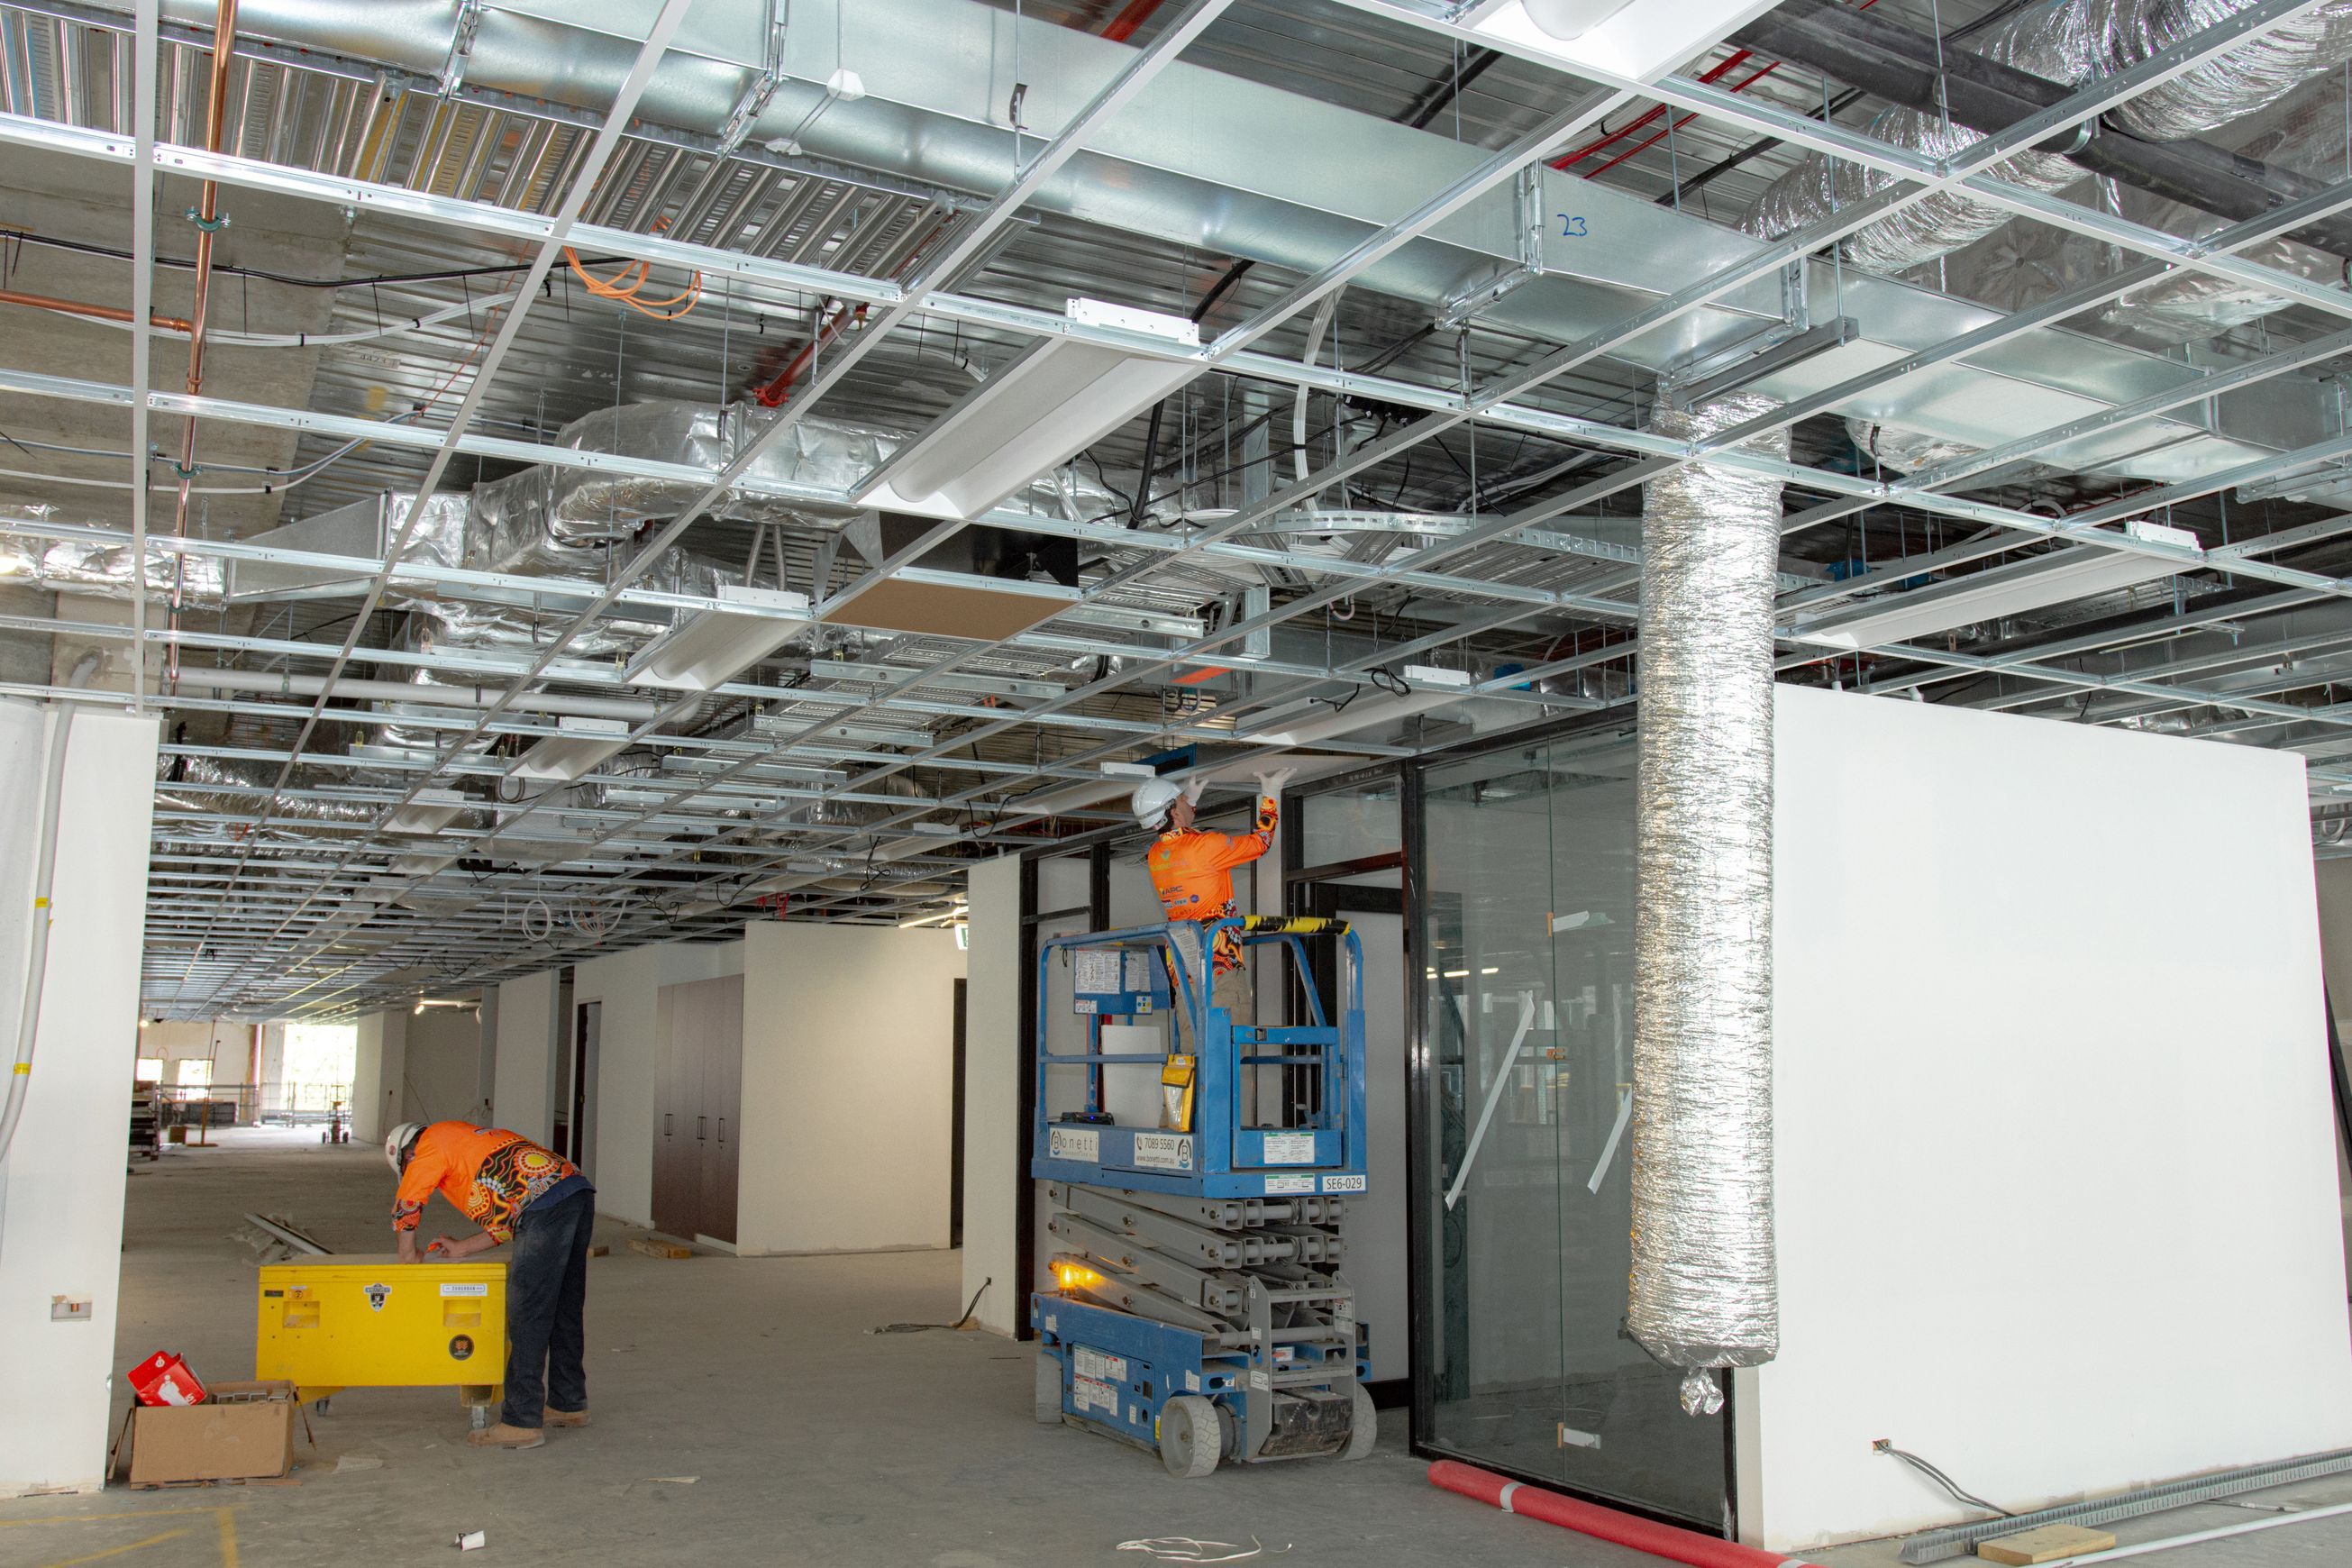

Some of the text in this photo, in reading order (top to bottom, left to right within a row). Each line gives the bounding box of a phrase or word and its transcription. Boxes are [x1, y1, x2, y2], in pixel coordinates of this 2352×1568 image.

[1556, 214, 1588, 236] 23
[1053, 1135, 1099, 1152] Bonetti
[1144, 1137, 1175, 1151] 7089 5560
[1326, 1177, 1363, 1190] SE6-029
